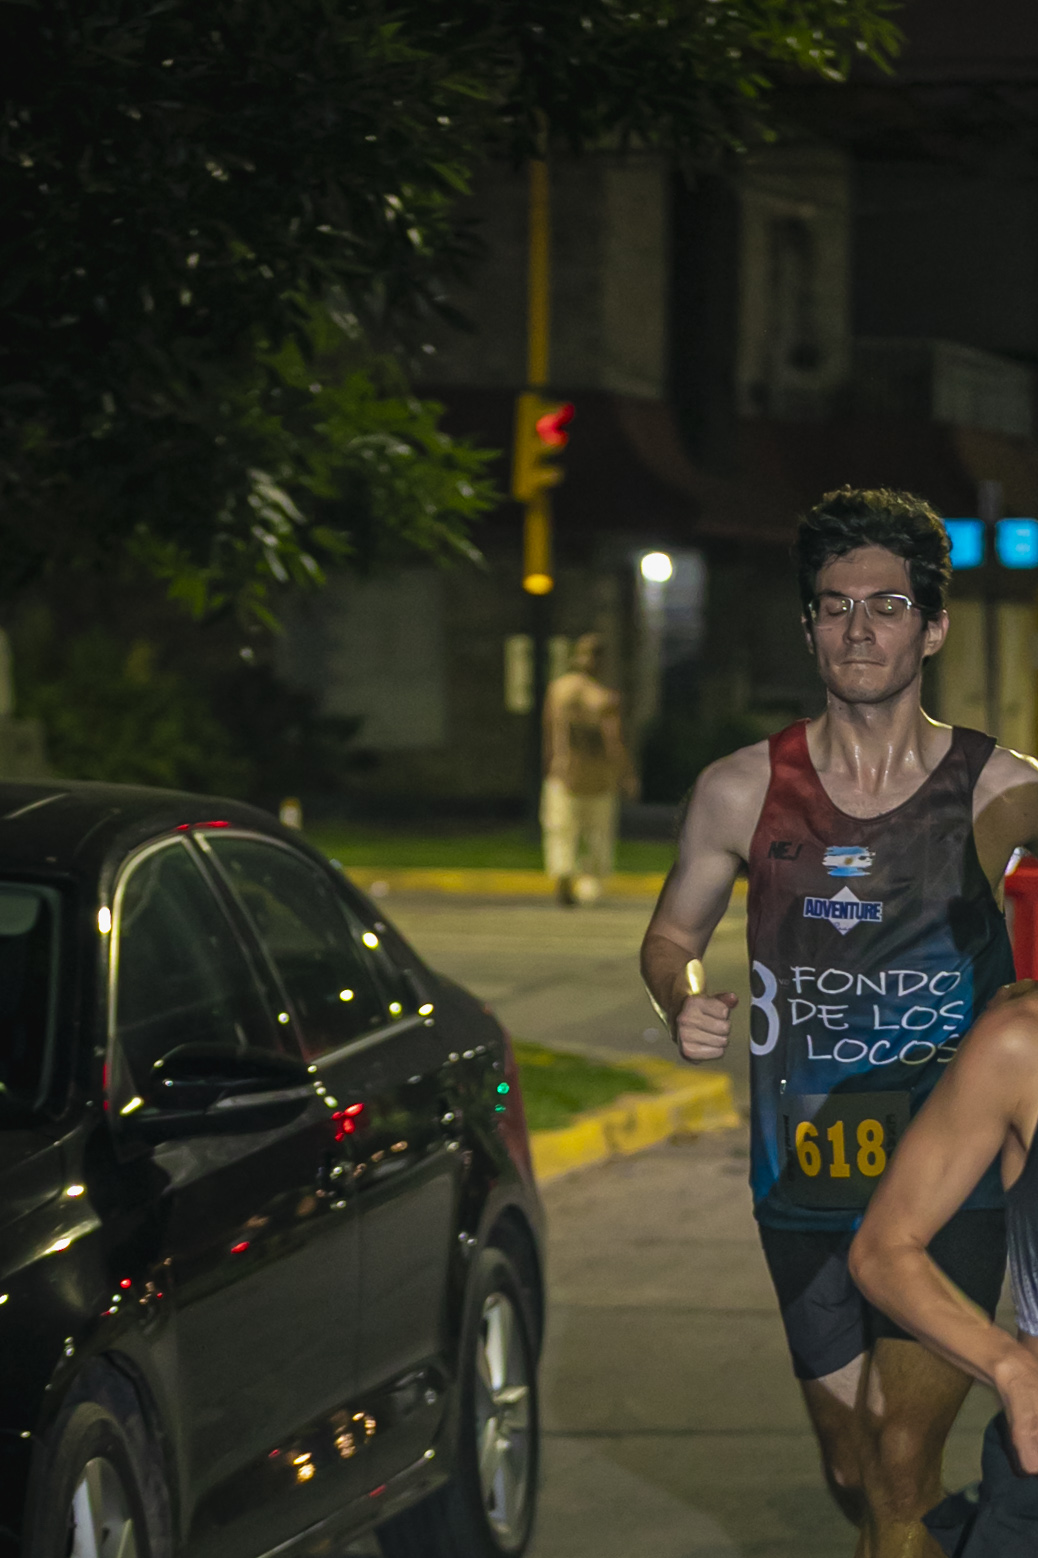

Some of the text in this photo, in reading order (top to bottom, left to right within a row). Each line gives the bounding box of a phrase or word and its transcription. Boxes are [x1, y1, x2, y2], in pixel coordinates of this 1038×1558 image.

[805, 898, 882, 921] ADVENTURE
[790, 966, 961, 996] FONDO
[787, 998, 964, 1031] DE LOS
[807, 1033, 960, 1065] LOCOS
[795, 1118, 887, 1178] 618
